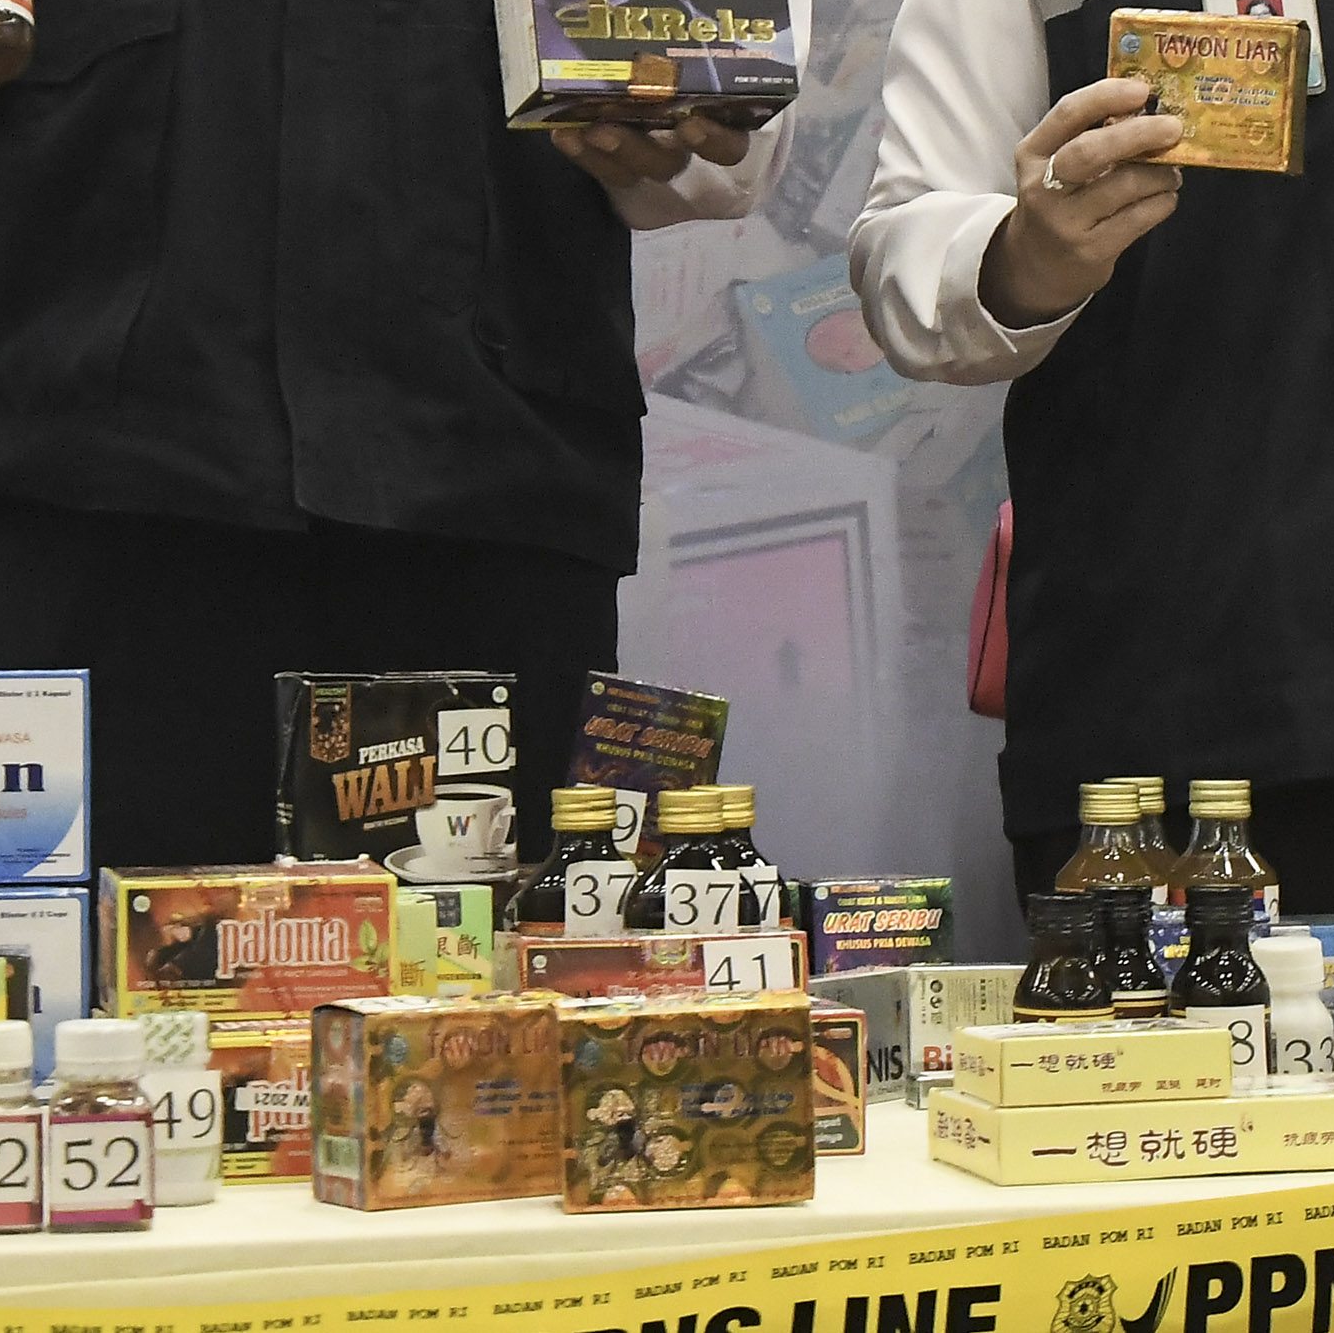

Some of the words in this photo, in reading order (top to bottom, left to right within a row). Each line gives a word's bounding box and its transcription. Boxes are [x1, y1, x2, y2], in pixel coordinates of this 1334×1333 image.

[1154, 33, 1228, 60] TAWON
[1236, 40, 1281, 63] LIAR
[358, 736, 427, 765] PERKASA
[446, 723, 510, 766] 40
[332, 755, 438, 822] WALI
[447, 815, 471, 837] W
[570, 873, 637, 918] 37
[668, 883, 735, 926] 37
[759, 878, 779, 921] 7
[823, 910, 873, 934] URAT
[873, 908, 943, 933] SERIBU
[836, 939, 873, 951] KHUSUS
[873, 937, 894, 950] PRIA
[709, 953, 766, 992] 41
[152, 1087, 216, 1139] 49
[62, 1137, 142, 1191] 52
[1031, 1126, 1240, 1167] 一想就硬
[771, 1262, 819, 1279] BADAN
[828, 1258, 858, 1271] POM
[866, 1256, 885, 1269] RI
[908, 1248, 956, 1265] BADAN
[966, 1244, 994, 1259] POM
[1002, 1240, 1019, 1254] RI
[1042, 1234, 1090, 1249] BADAN
[1100, 1230, 1128, 1244] POM
[1136, 1227, 1154, 1240] RI
[1177, 1219, 1222, 1236] BADAN
[1231, 1215, 1258, 1230] POM
[1266, 1212, 1283, 1226] RI
